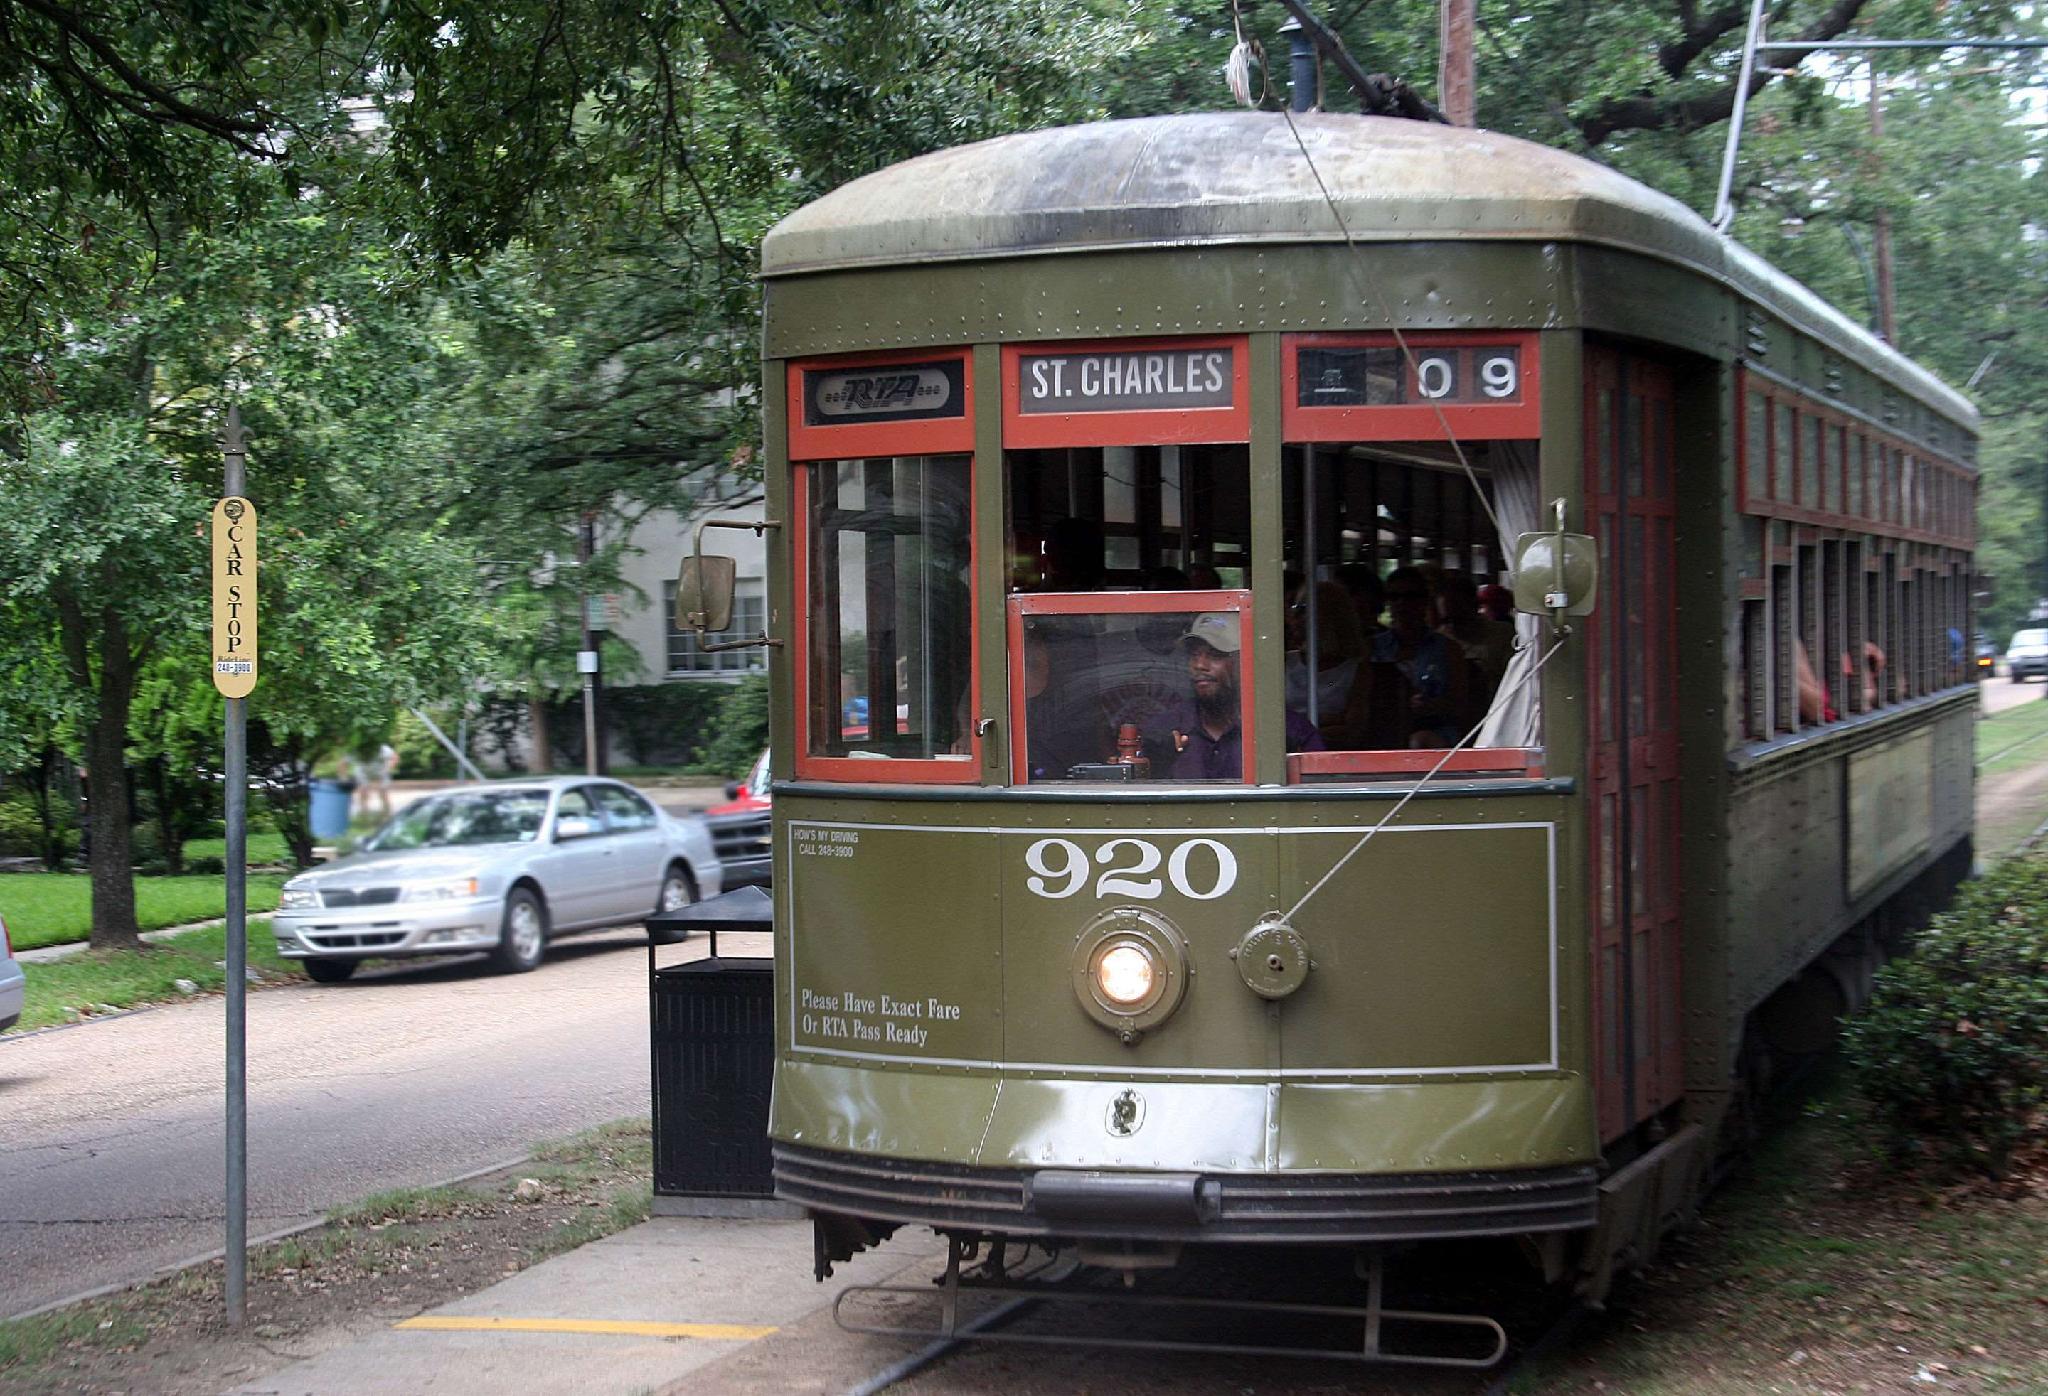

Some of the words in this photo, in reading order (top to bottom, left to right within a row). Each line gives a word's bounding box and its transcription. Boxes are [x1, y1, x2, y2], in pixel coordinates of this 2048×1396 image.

[844, 374, 920, 404] RTA
[1032, 359, 1072, 398] ST.
[1081, 353, 1223, 397] CHARLES
[1418, 358, 1451, 398] 0
[1482, 357, 1516, 397] 9
[226, 525, 243, 576] CAR
[227, 585, 242, 653] STOP
[794, 829, 816, 840] HOW'S
[817, 830, 829, 841] MY
[830, 831, 859, 843] DRIVING
[799, 843, 816, 855] CALL
[1025, 838, 1238, 899] 920
[802, 989, 839, 1011] Please
[843, 992, 875, 1014] Have
[880, 995, 922, 1018] Exact
[928, 998, 960, 1020] Fare
[803, 1014, 817, 1034] Or
[822, 1016, 848, 1038] RTA
[853, 1019, 880, 1041] Pass
[886, 1022, 928, 1048] Ready
